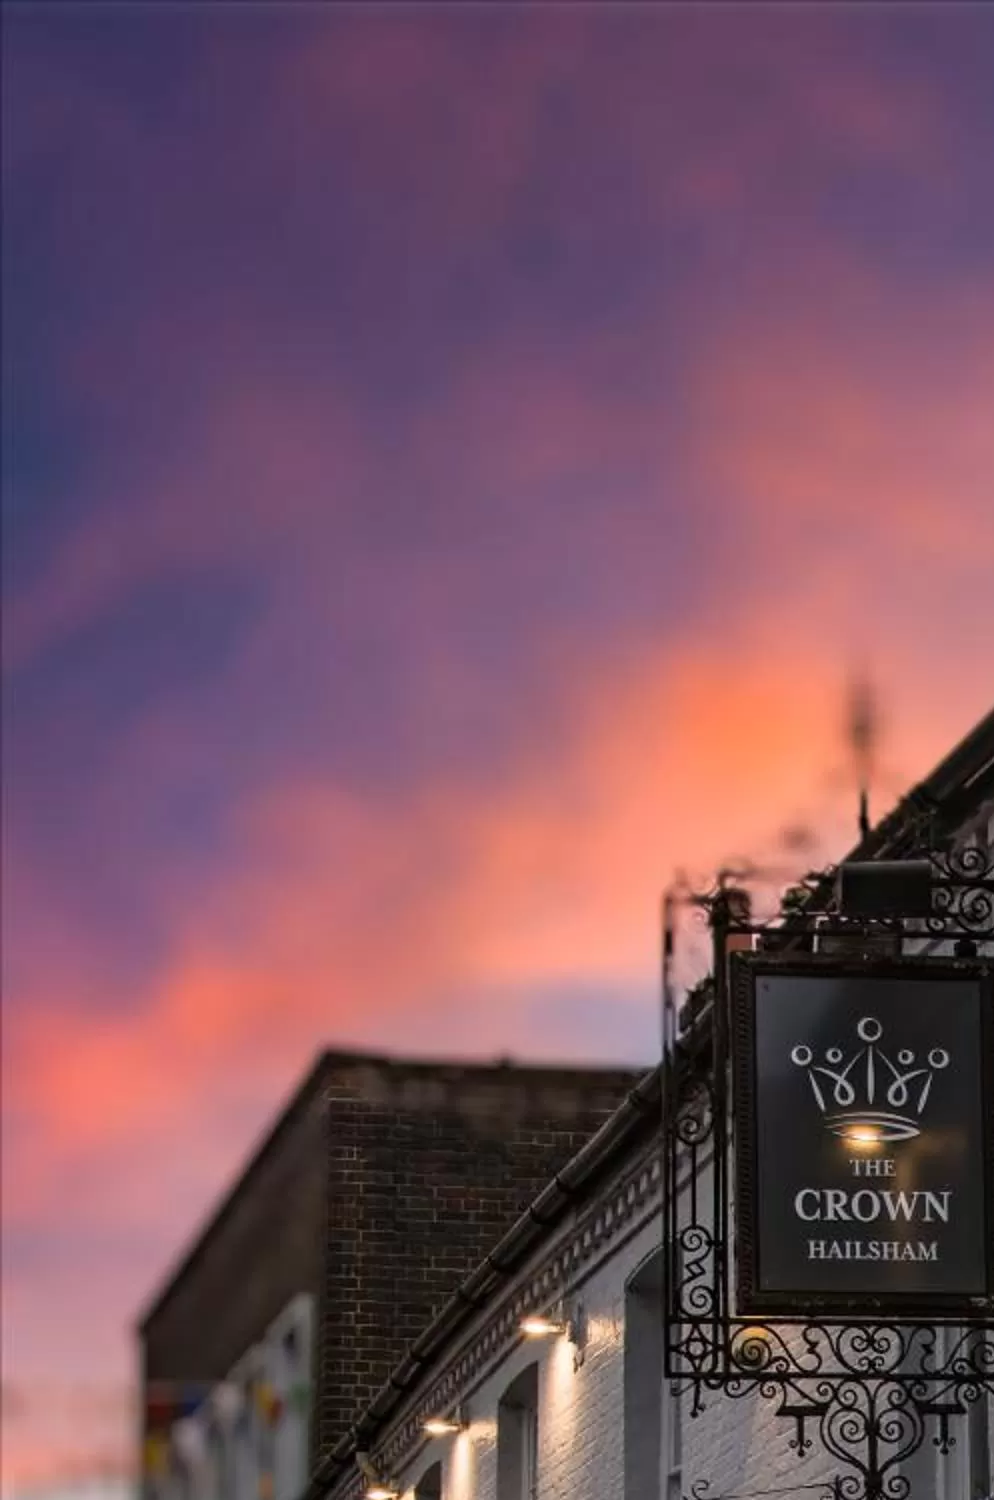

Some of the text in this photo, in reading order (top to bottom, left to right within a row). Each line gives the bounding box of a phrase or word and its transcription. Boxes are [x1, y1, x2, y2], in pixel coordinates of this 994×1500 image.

[850, 1159, 897, 1177] THE
[794, 1188, 952, 1223] CROWN
[807, 1239, 939, 1261] HAILSHAM
